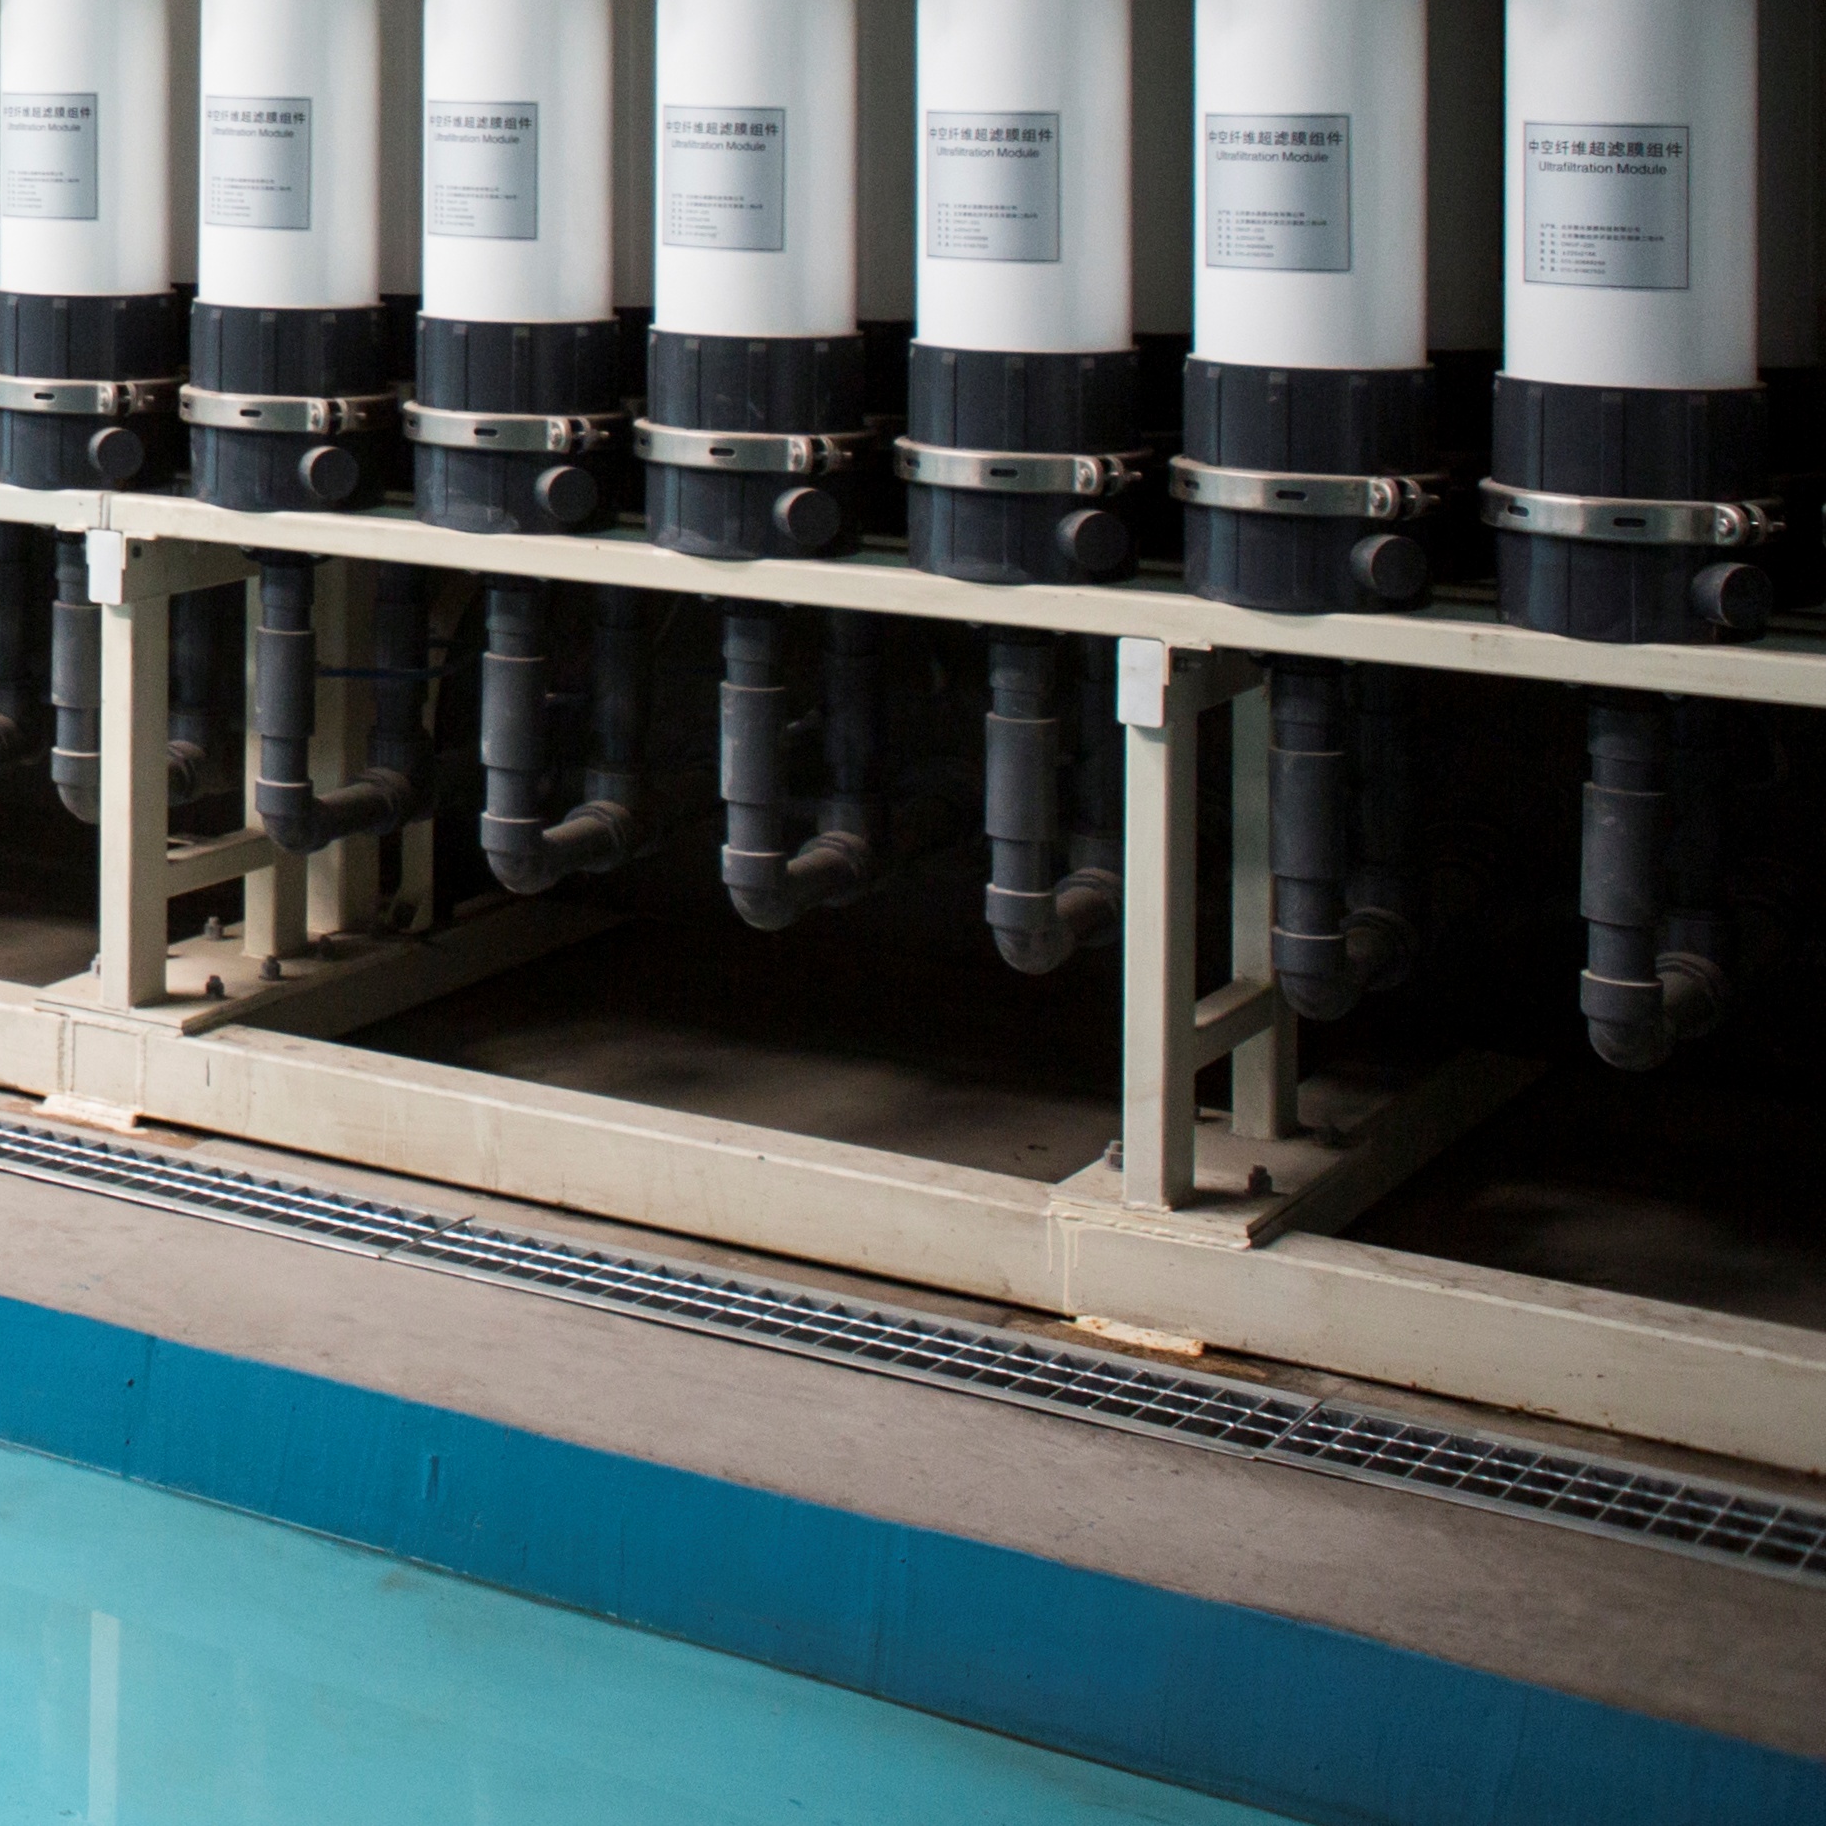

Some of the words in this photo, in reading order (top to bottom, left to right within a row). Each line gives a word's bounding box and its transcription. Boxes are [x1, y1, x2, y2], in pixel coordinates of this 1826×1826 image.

[726, 141, 766, 151] Module
[997, 148, 1039, 158] Module
[1216, 151, 1279, 162] Ultrafiltration
[1282, 152, 1329, 163] Module
[1539, 161, 1613, 174] Ultrafiltration
[1617, 163, 1667, 175] Module
